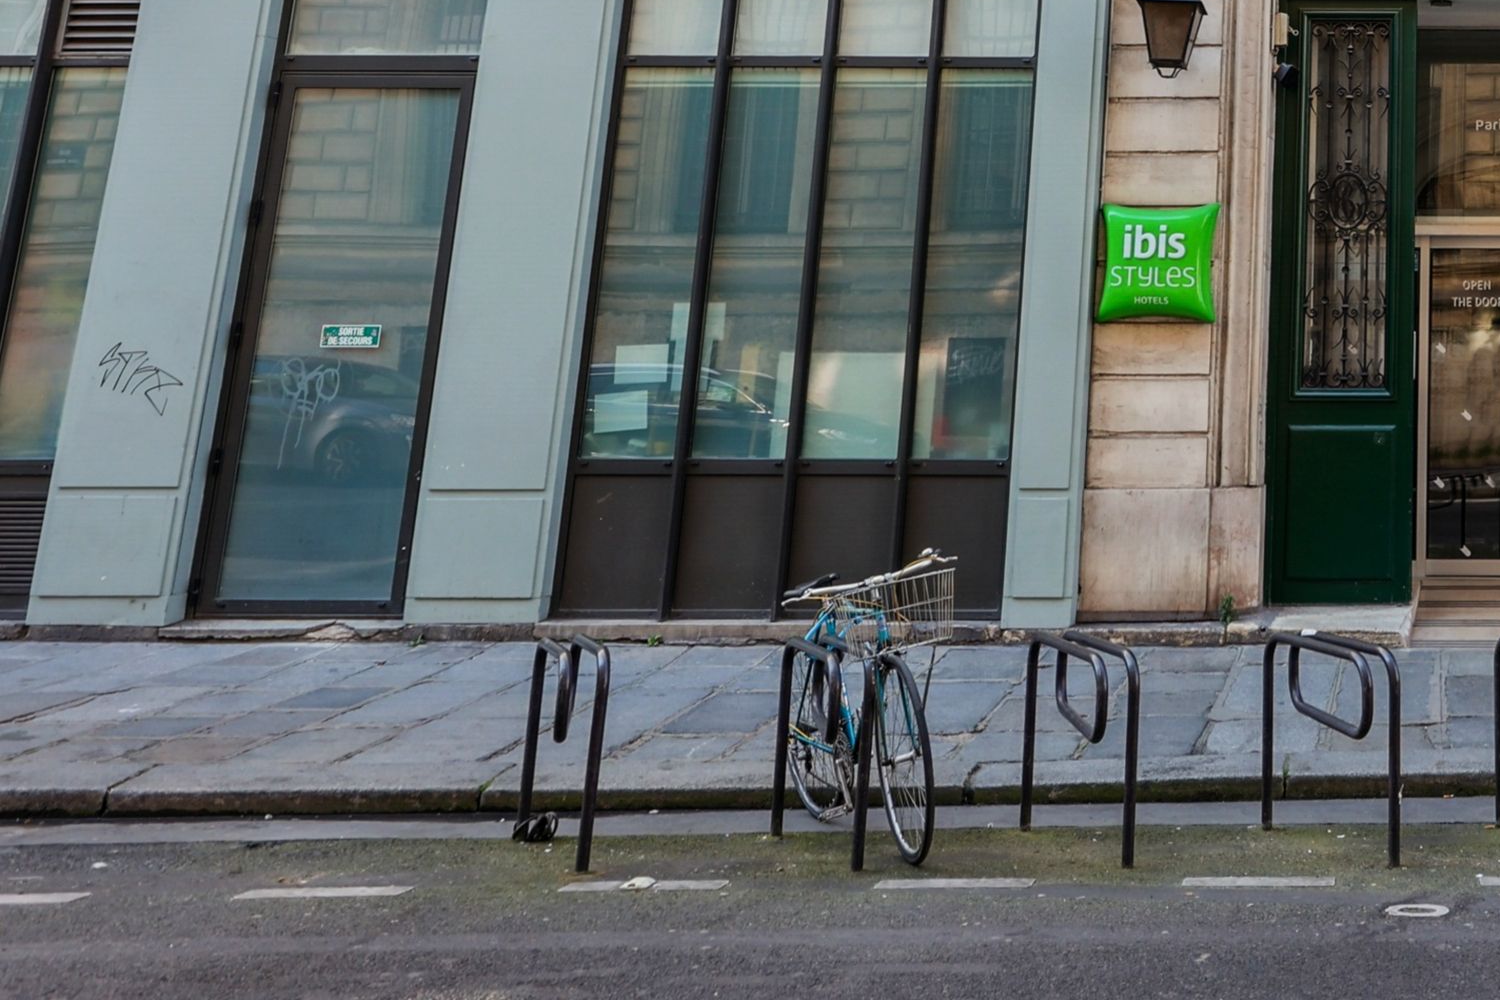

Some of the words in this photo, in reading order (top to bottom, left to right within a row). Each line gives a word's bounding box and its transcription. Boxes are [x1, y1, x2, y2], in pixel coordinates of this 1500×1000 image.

[1123, 224, 1186, 259] ibis
[1462, 280, 1492, 291] OPEN
[1134, 296, 1169, 305] HOTELS
[1451, 296, 1473, 308] THE
[339, 327, 365, 336] SORTIE
[327, 336, 338, 345] DE
[339, 336, 373, 345] SECOURS
